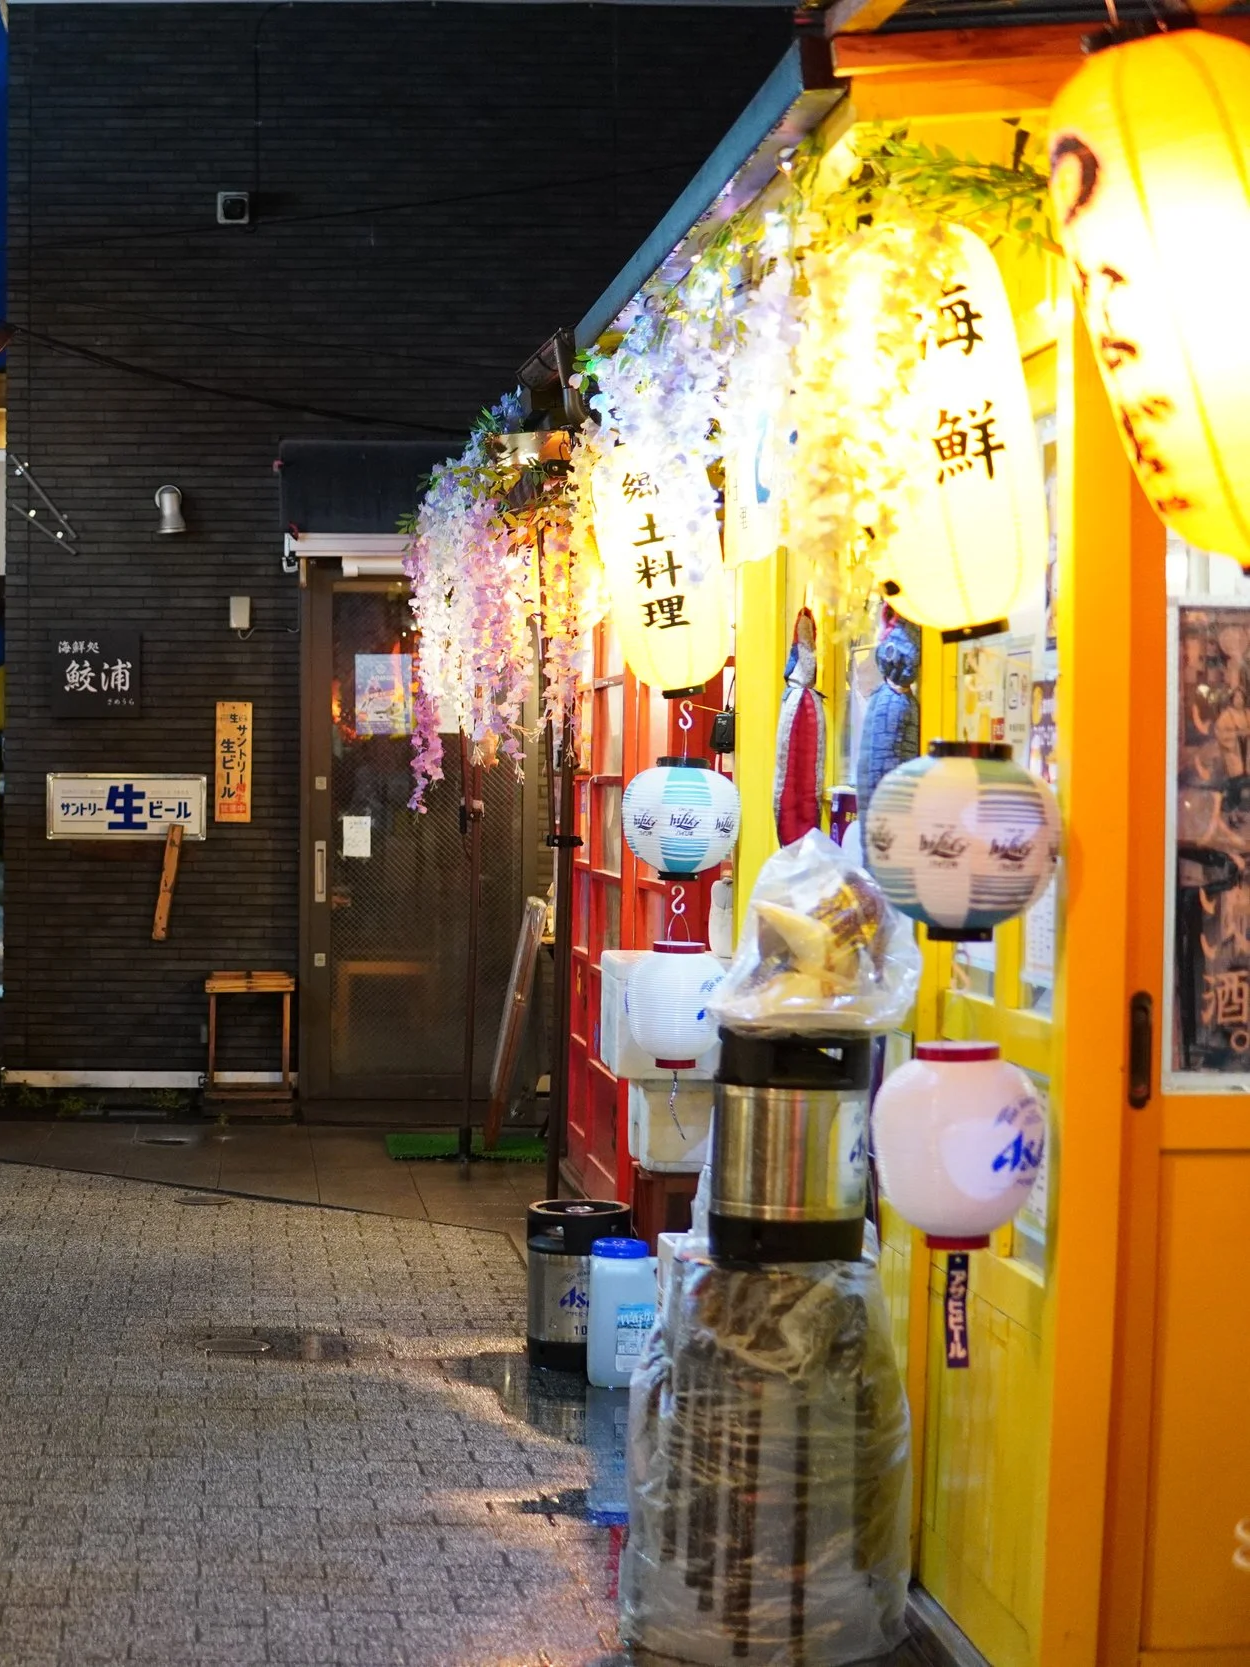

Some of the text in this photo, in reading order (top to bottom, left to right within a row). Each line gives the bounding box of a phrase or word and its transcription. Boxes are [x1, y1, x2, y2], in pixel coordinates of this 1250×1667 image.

[914, 283, 1006, 485] 海鮮
[58, 640, 100, 654] 海鮮処
[64, 658, 133, 693] 鮫浦
[107, 698, 135, 706] さめうら
[220, 738, 236, 799] 生ビール
[236, 724, 248, 785] サントリー
